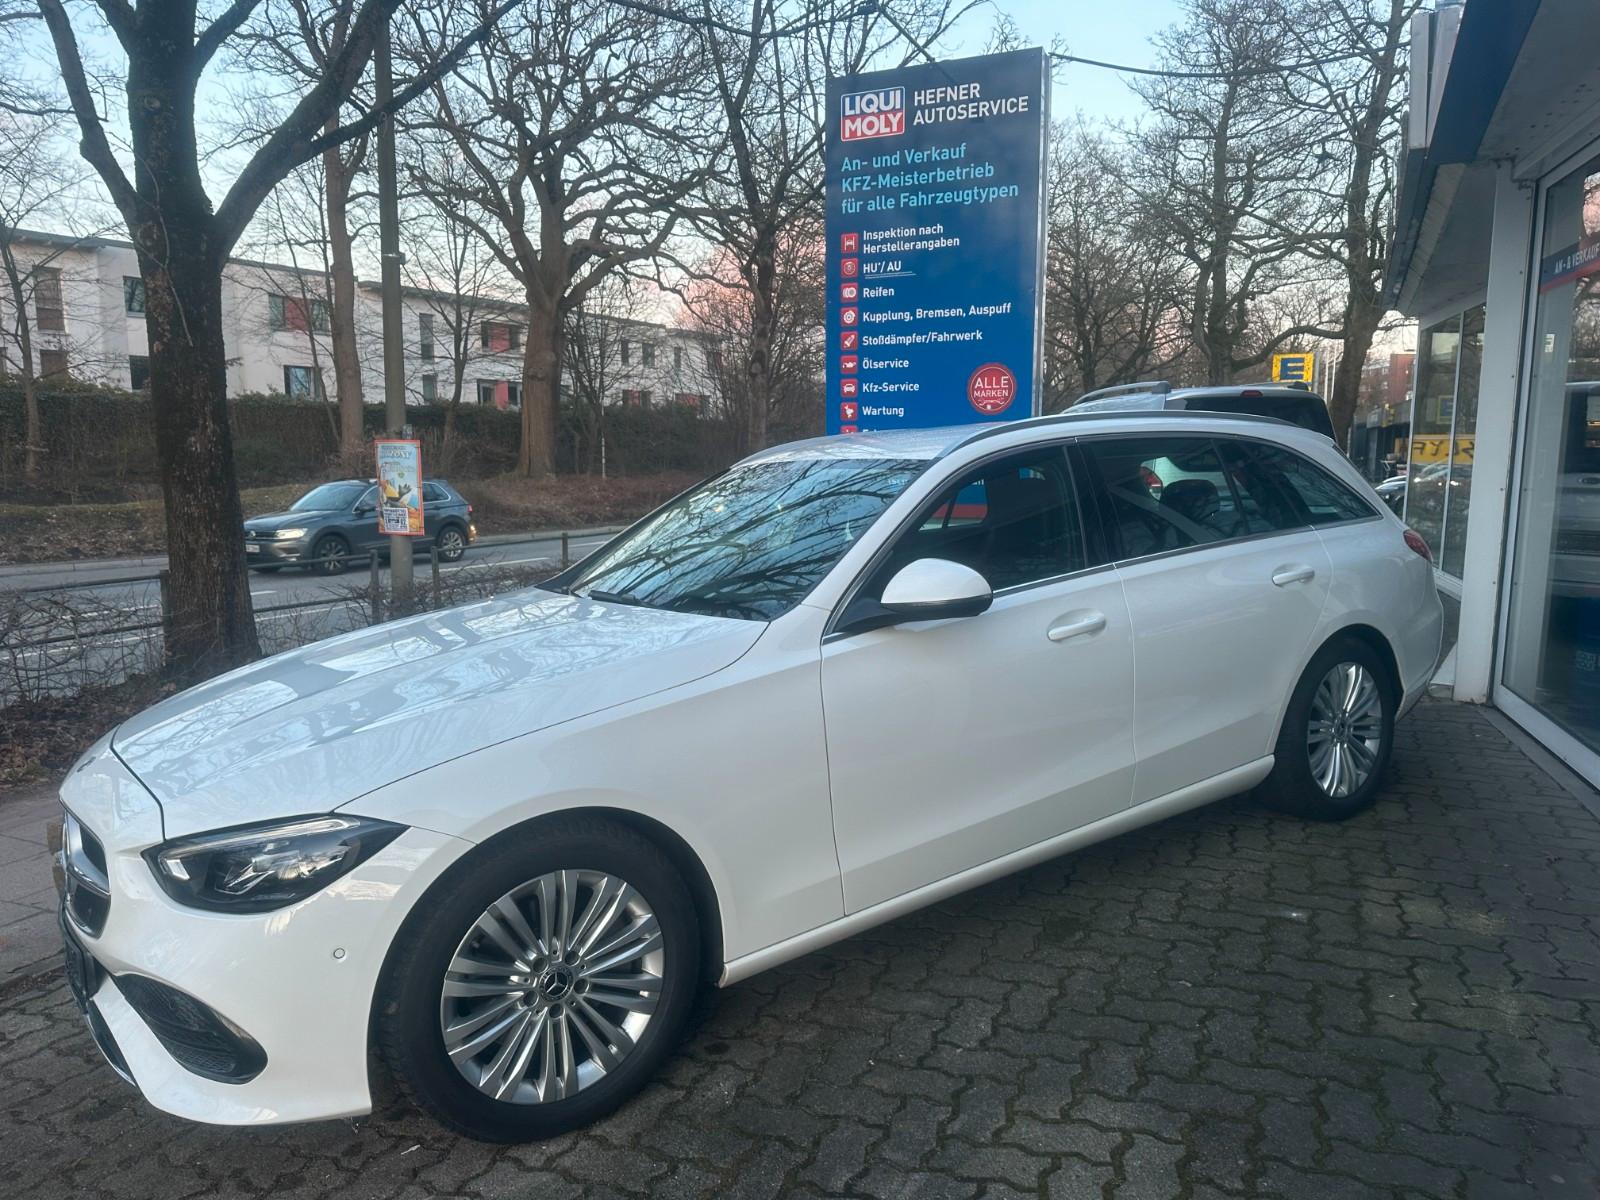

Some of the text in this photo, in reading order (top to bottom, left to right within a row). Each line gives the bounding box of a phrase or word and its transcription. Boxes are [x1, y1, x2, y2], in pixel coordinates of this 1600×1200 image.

[844, 89, 901, 116] LIQUI
[914, 83, 980, 106] HEFNER
[913, 96, 1029, 126] AUTOSERVICE
[844, 112, 903, 138] MOLY
[841, 143, 967, 172] An- und Verkauf
[841, 162, 995, 192] KFZ-Meisterbetrieb
[841, 184, 1018, 214] für alle Fahrzeugtypen
[863, 224, 944, 241] Inspektion nach
[863, 237, 960, 254] Herstellerangaben
[863, 286, 895, 298] Reifen
[863, 303, 1012, 323] Kupplung, Bremsen, Auspuff
[862, 329, 983, 346] Stoßdämpfer/Fahrwerk
[862, 357, 910, 370] Ölservice
[1280, 357, 1305, 380] E
[862, 381, 920, 393] Kfz-Service
[974, 375, 1009, 389] ALLE
[973, 389, 1009, 398] MARKEN
[862, 405, 905, 417] Wartung
